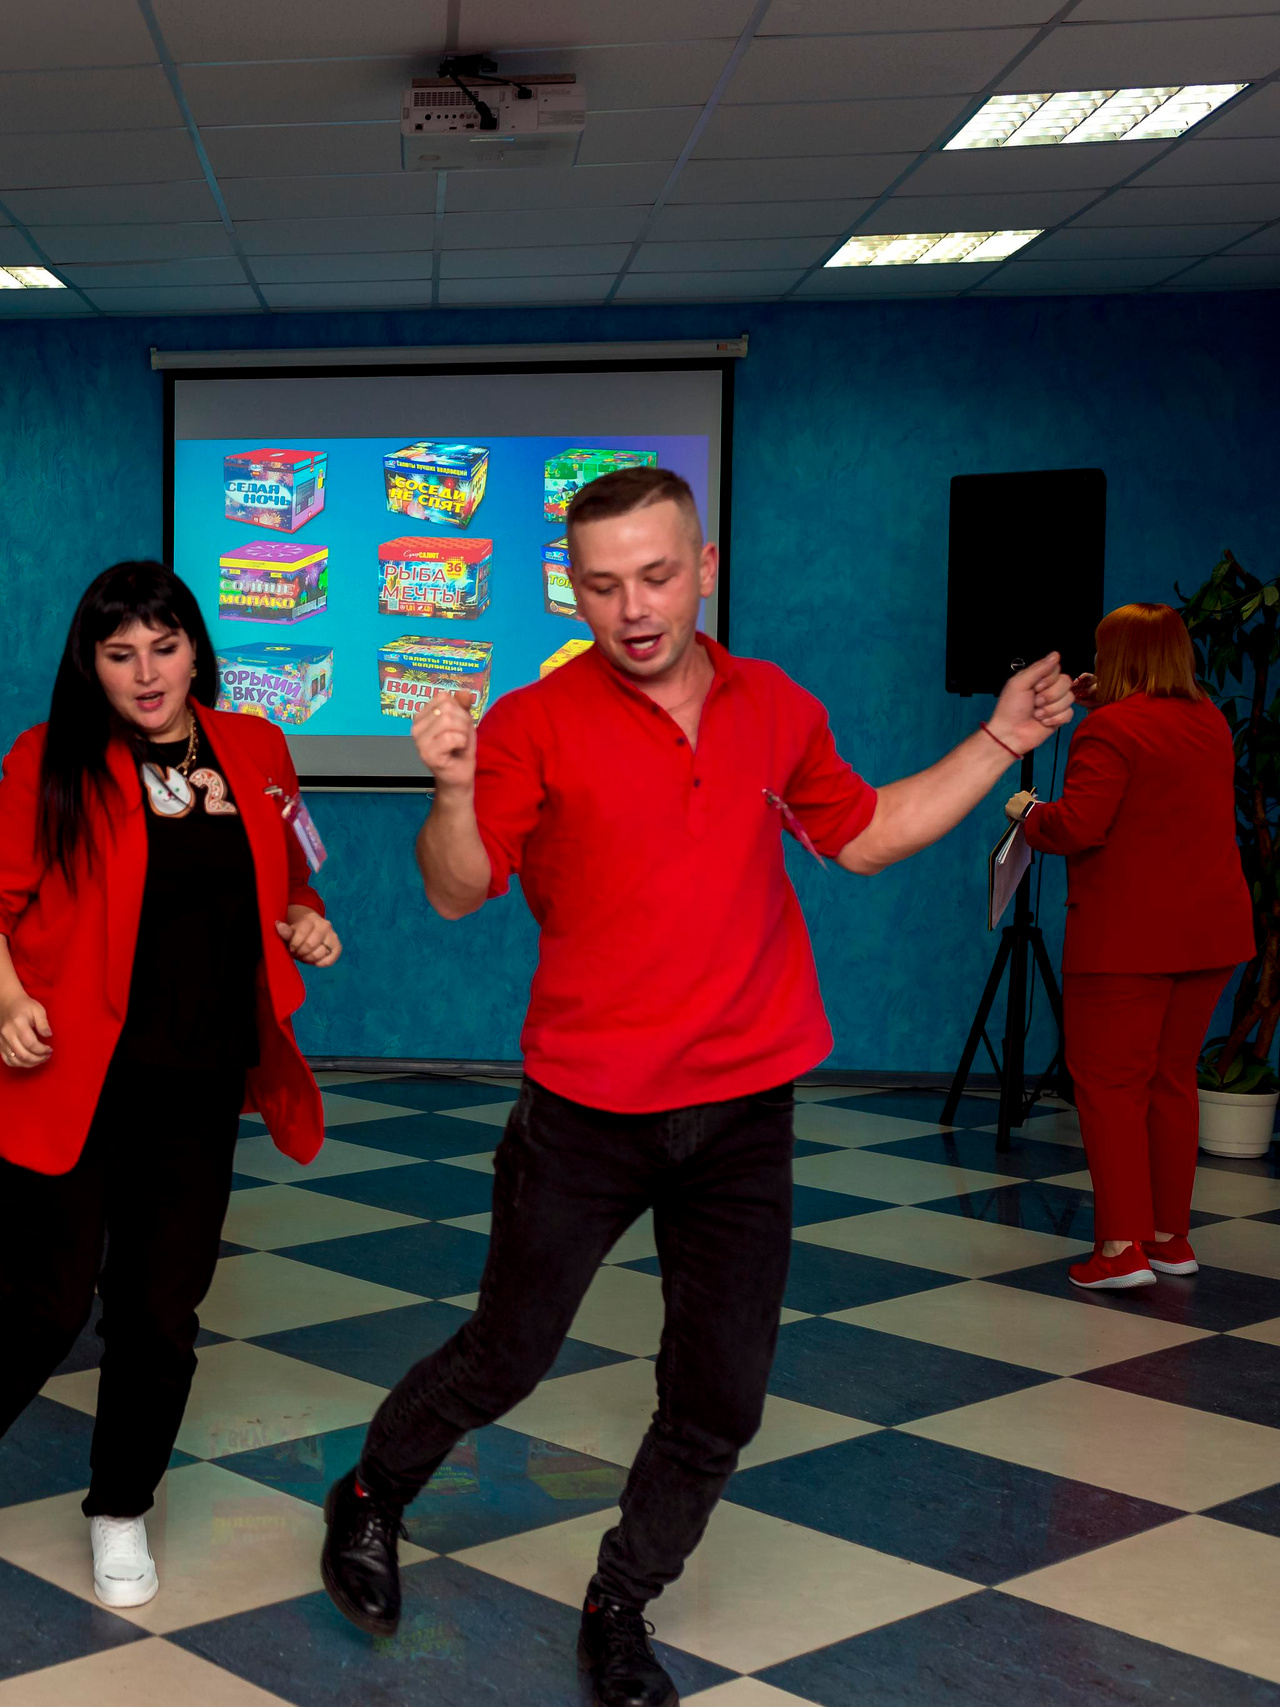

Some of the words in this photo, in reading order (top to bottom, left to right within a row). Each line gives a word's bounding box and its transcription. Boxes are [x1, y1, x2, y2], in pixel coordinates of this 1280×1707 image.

[225, 482, 280, 495] СЕДАЯ
[395, 477, 467, 502] СОСЕДИ
[243, 493, 291, 506] НОЧЬ
[390, 488, 414, 502] НЕ
[418, 494, 465, 513] СПЯТ
[384, 565, 447, 583] РЫБА
[446, 562, 462, 573] 36
[219, 593, 295, 609] МОНАКО
[382, 585, 461, 604] МЕЧТЫ
[218, 670, 302, 699] ОРЬКИЙ
[233, 686, 278, 707] ВКУС
